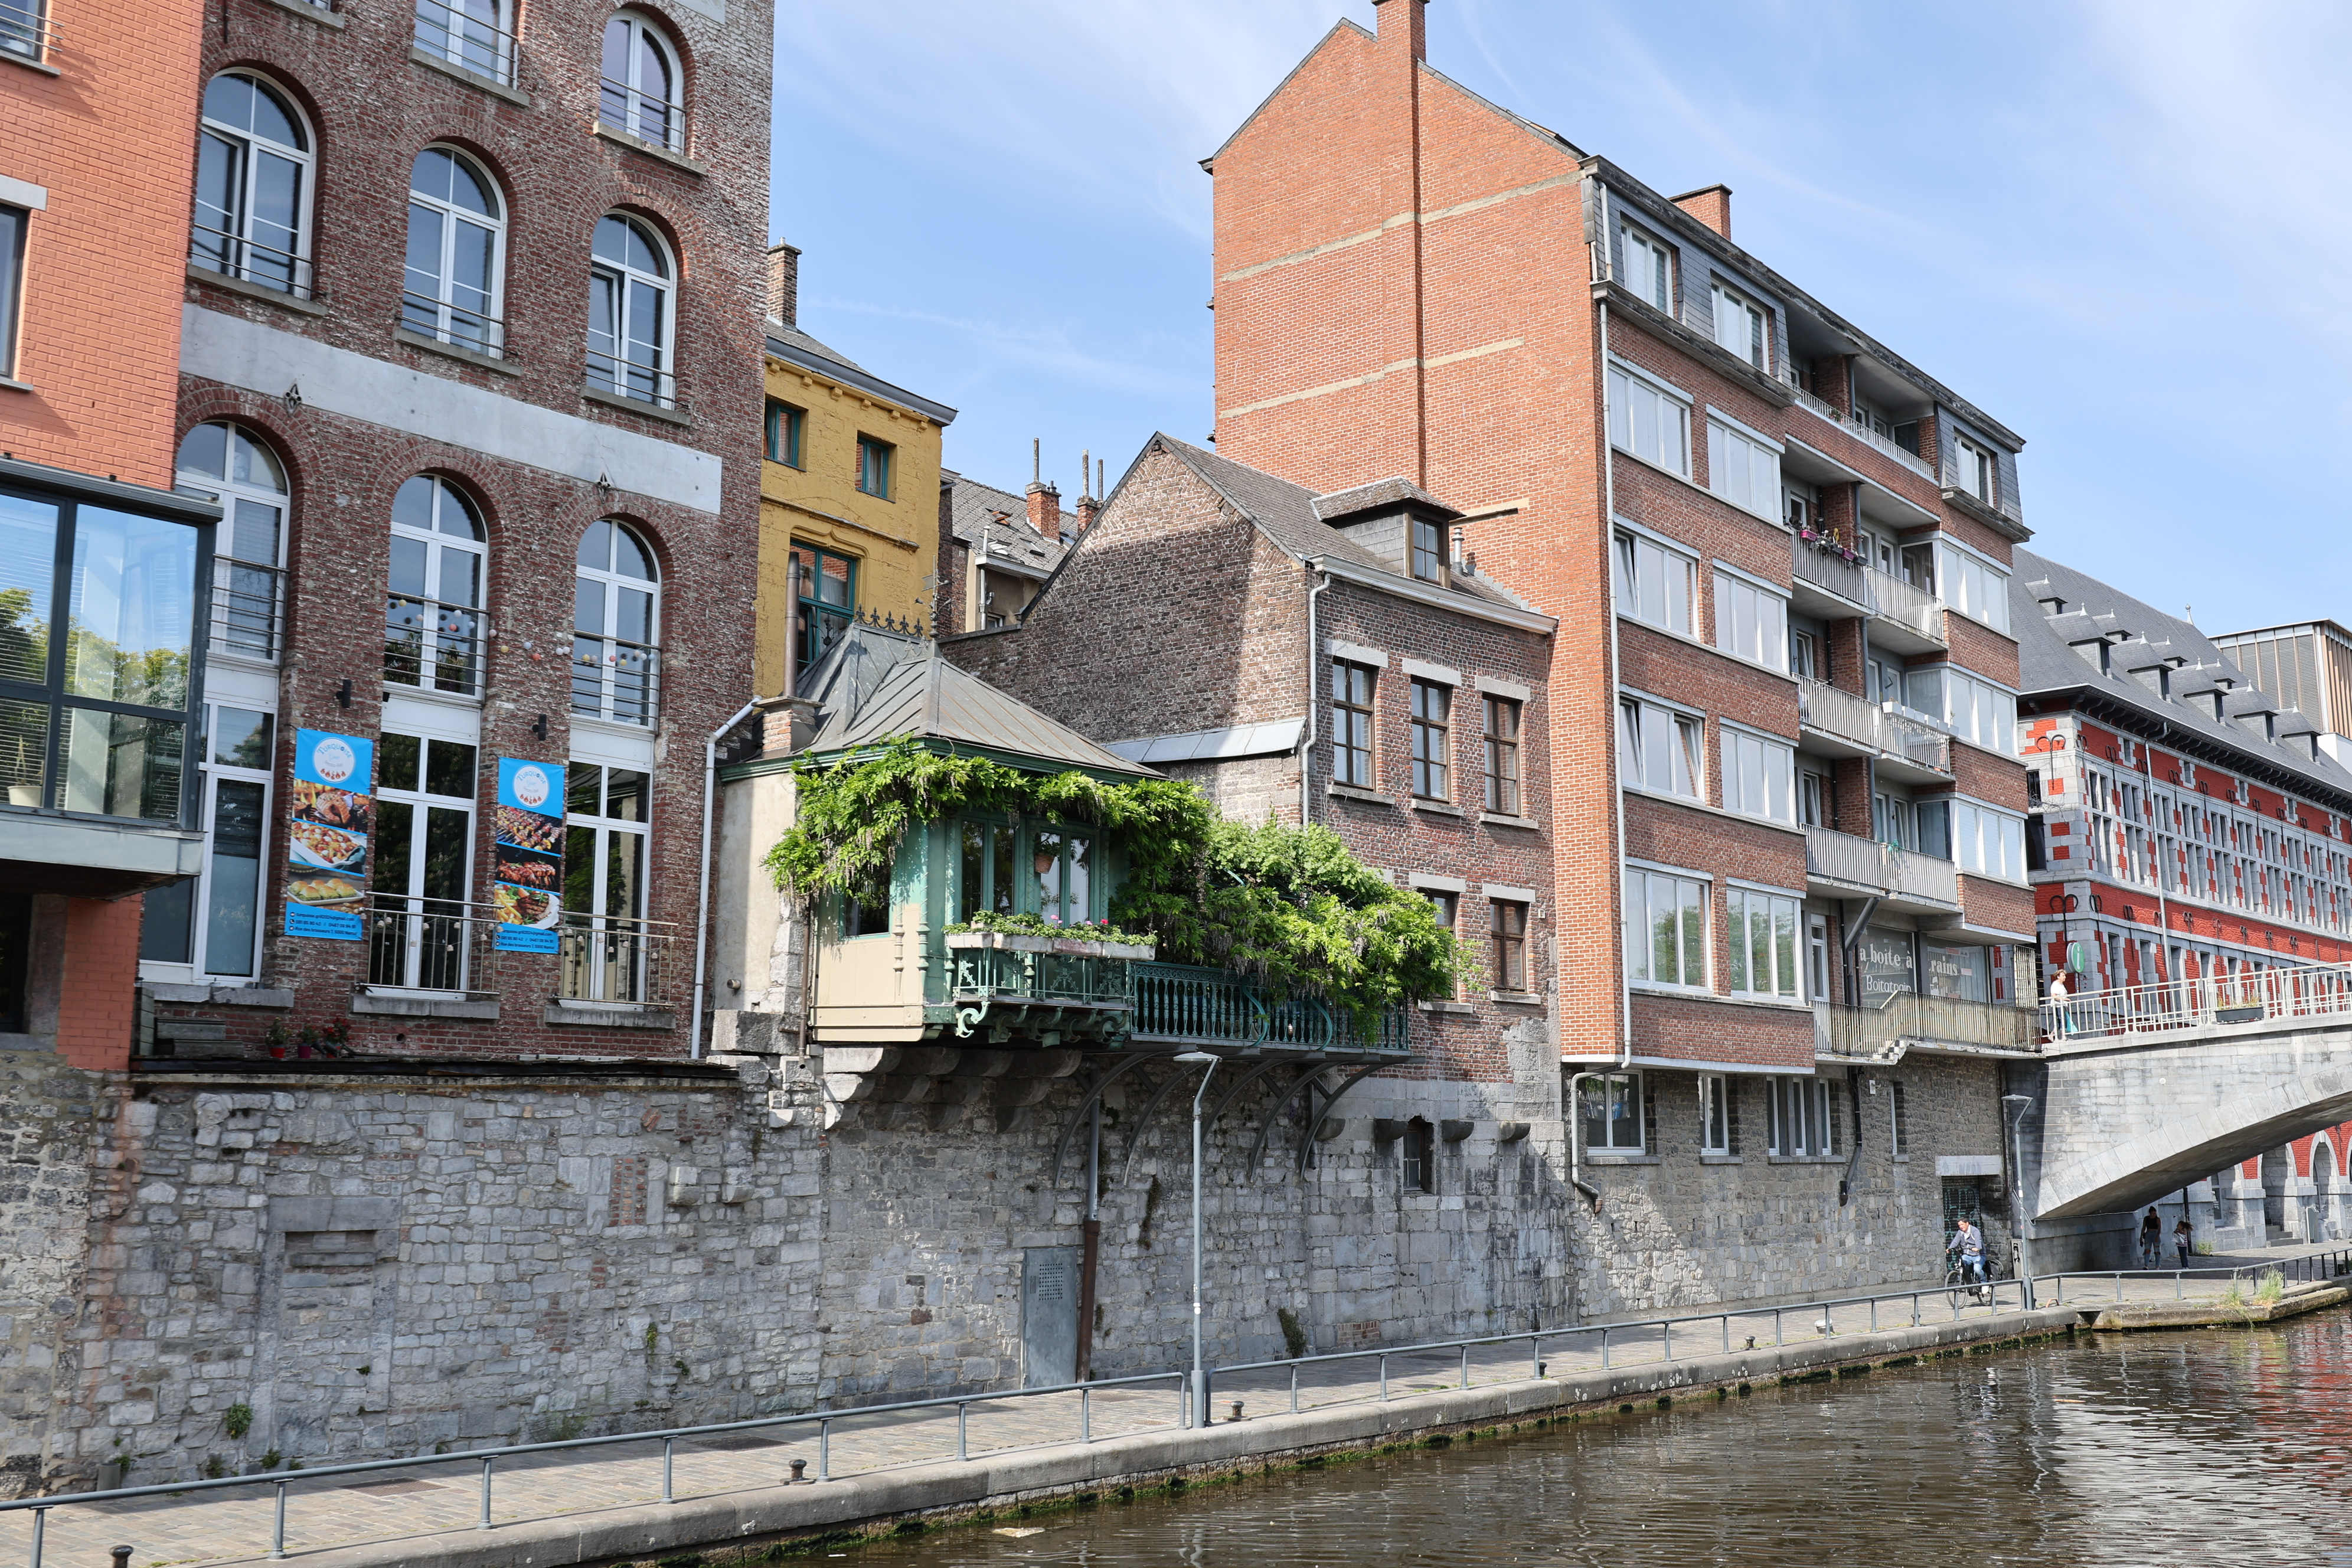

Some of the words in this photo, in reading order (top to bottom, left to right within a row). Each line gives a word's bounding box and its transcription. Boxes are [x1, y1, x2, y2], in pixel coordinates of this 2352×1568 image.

[1870, 943, 1902, 967] boite
[1906, 950, 1913, 969] à
[1928, 955, 1958, 976] rains
